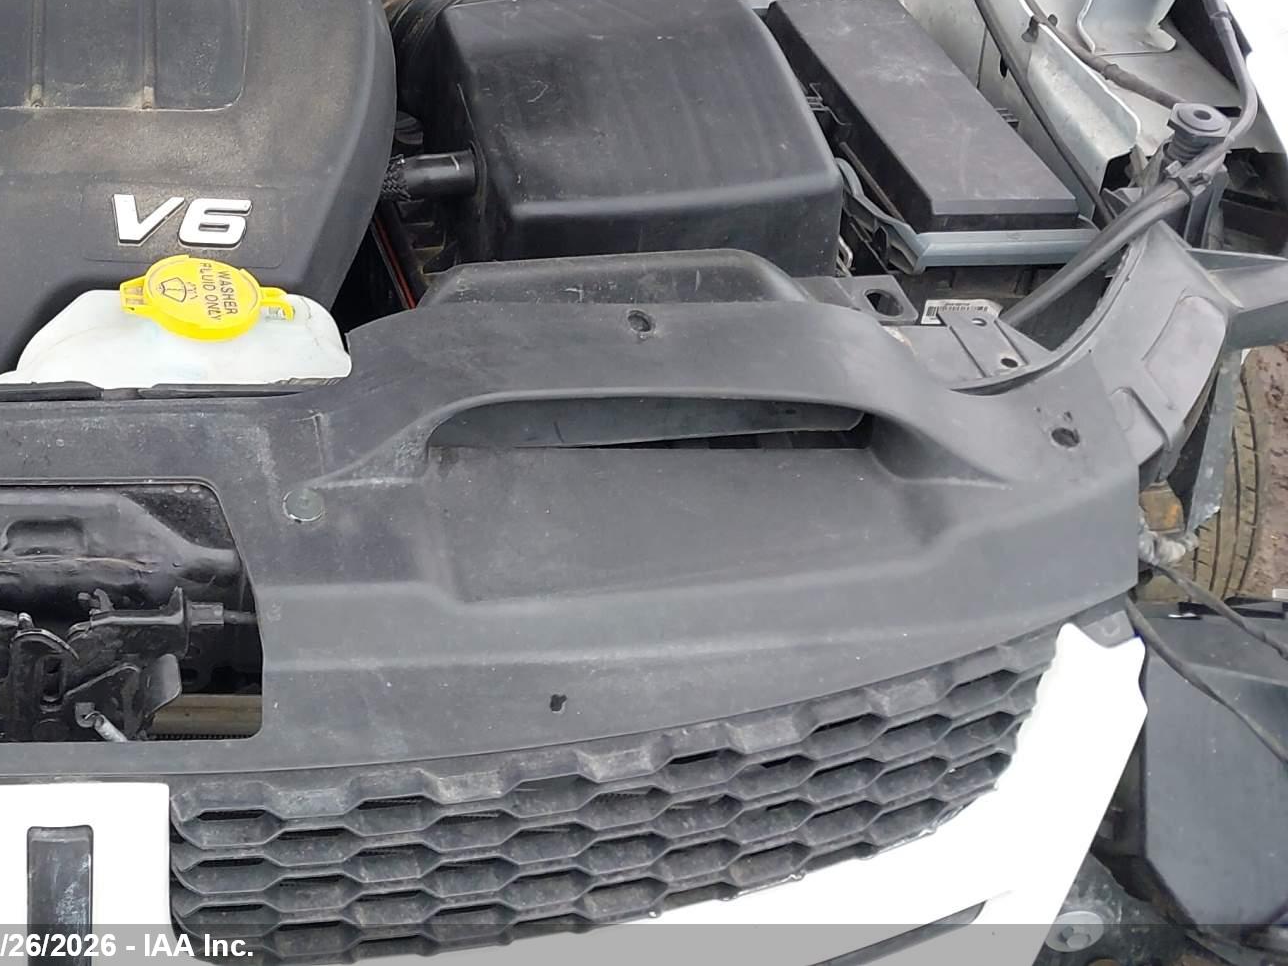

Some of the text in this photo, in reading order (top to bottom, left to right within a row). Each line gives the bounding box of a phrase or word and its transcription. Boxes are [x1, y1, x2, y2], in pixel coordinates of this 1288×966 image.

[113, 193, 252, 248] V6
[200, 262, 222, 321] FLUID ONLY
[218, 270, 238, 315] WASHER
